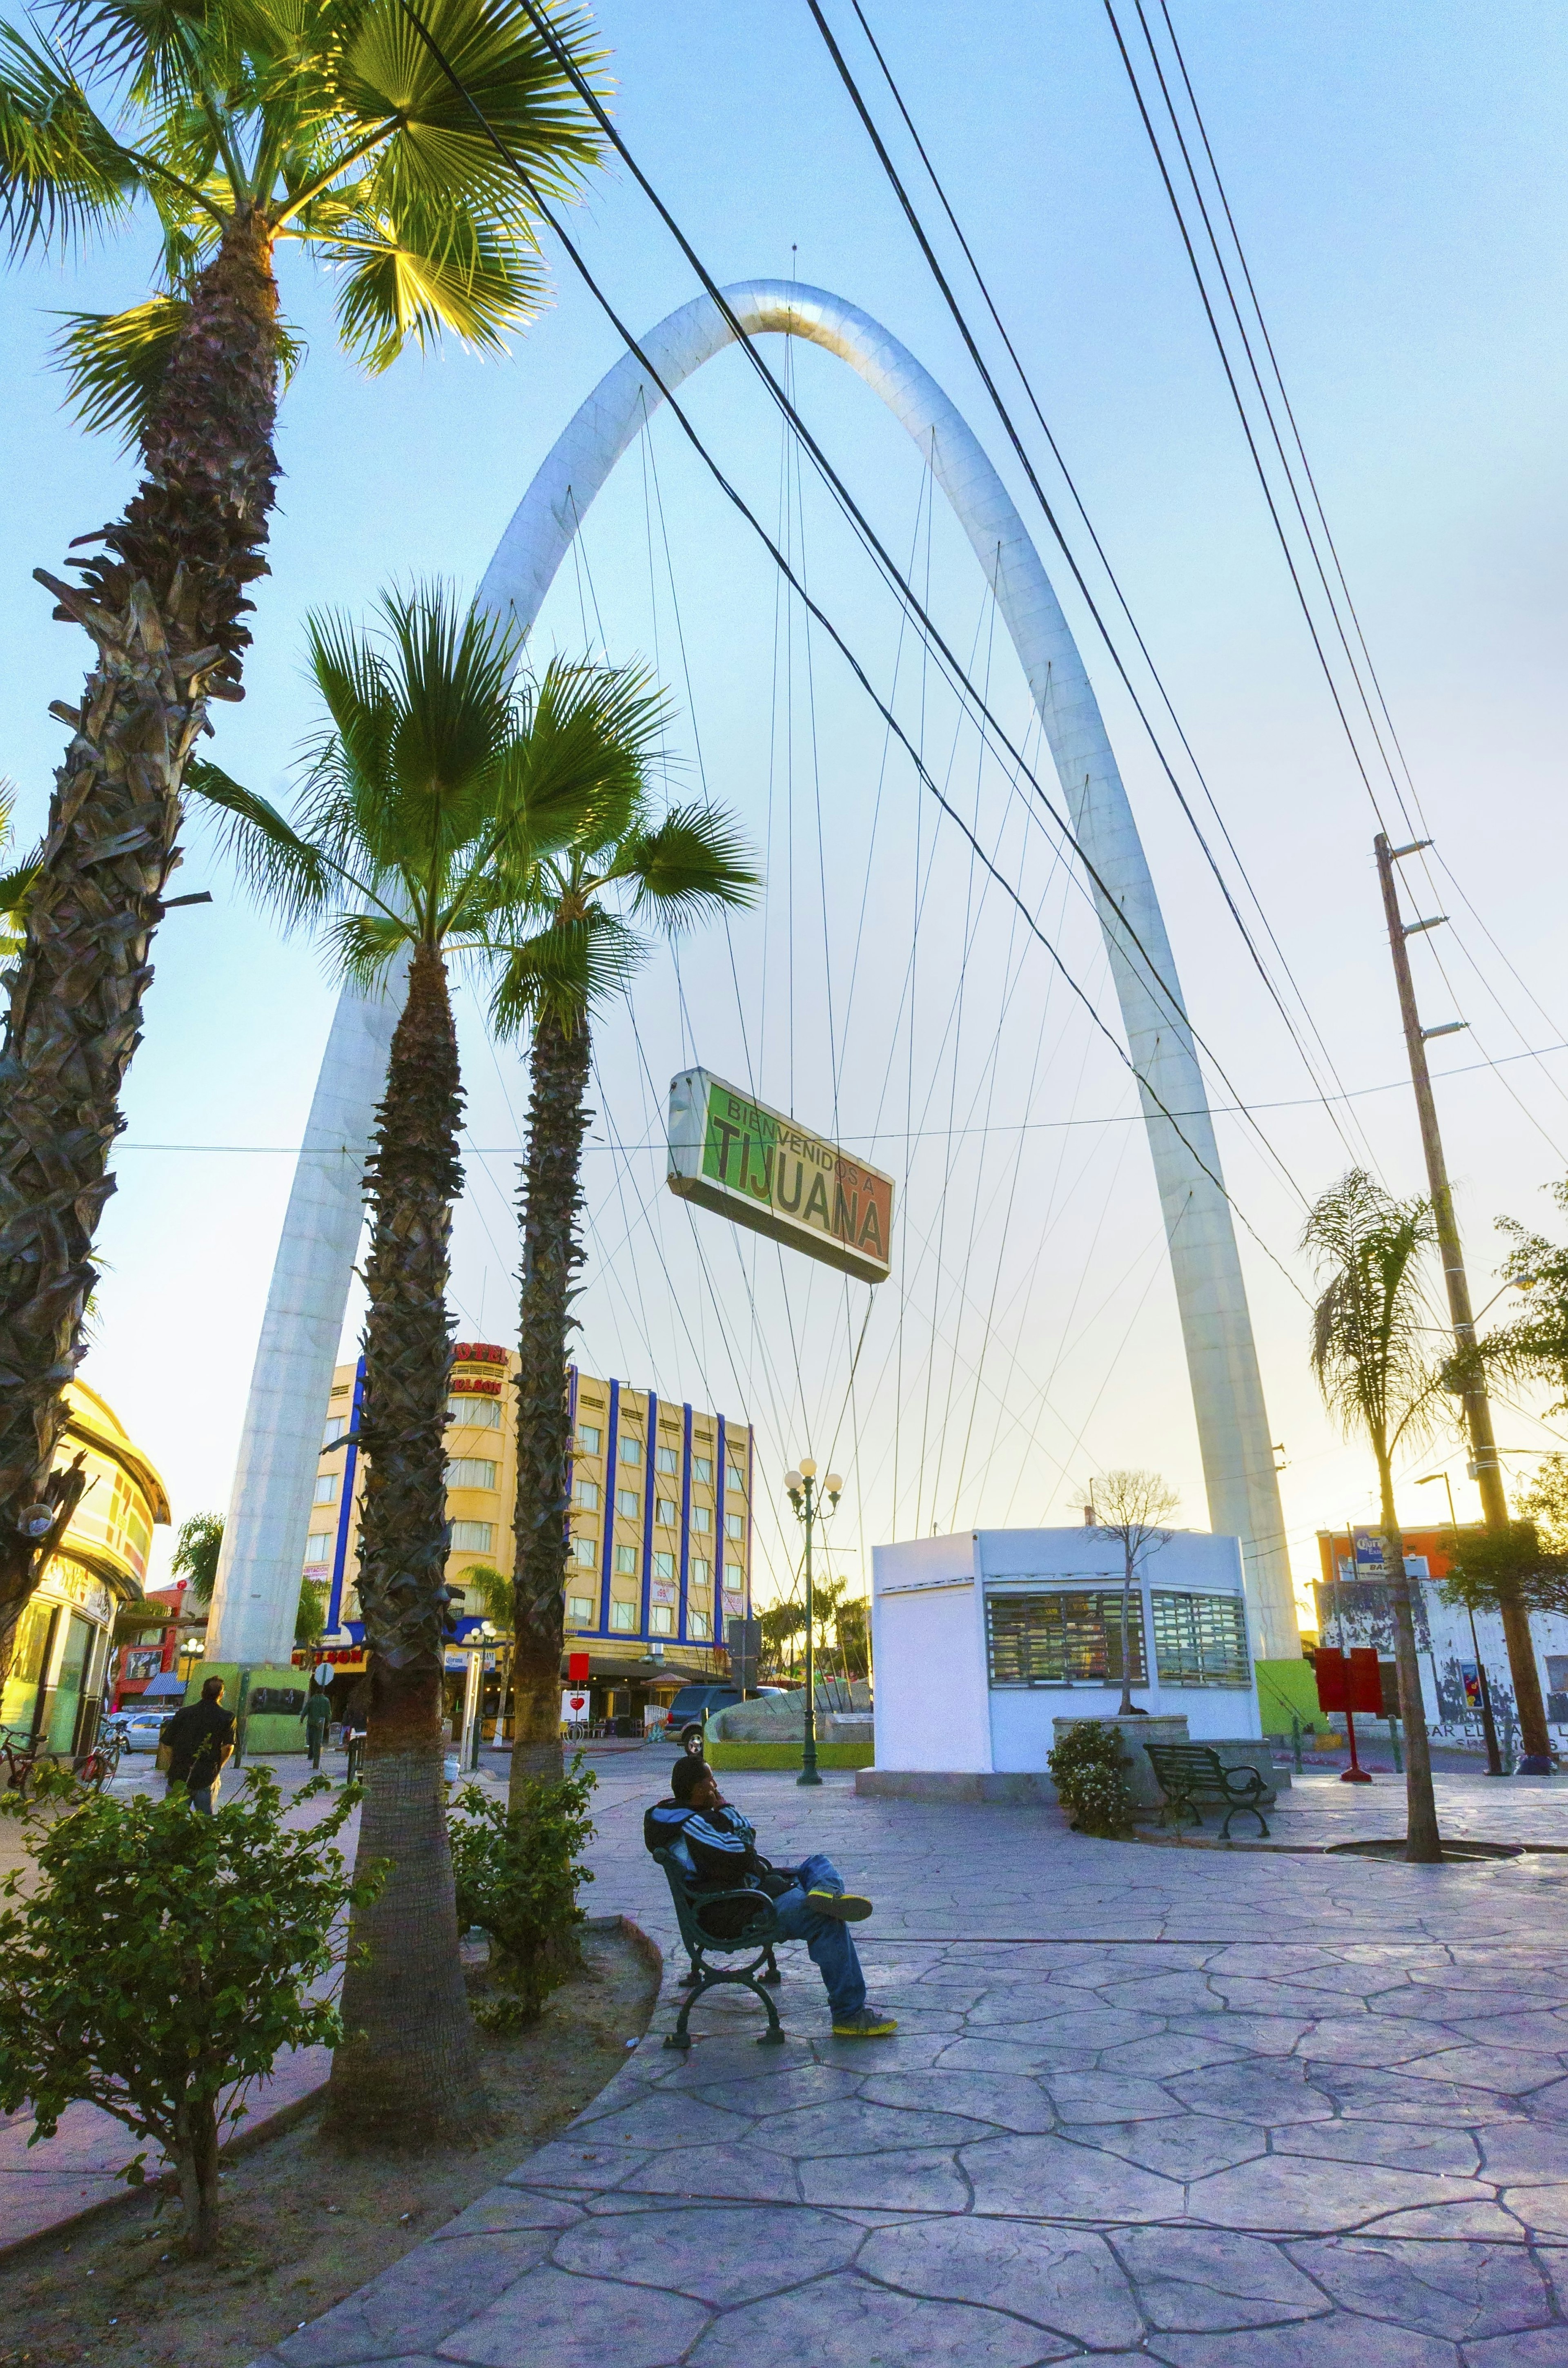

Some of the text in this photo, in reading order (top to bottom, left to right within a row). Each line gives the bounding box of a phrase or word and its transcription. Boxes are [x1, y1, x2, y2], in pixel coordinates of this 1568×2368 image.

[713, 1116, 884, 1257] TIJUANA
[727, 1097, 874, 1195] BIENVENIDOS A
[451, 1342, 509, 1365] OTEL
